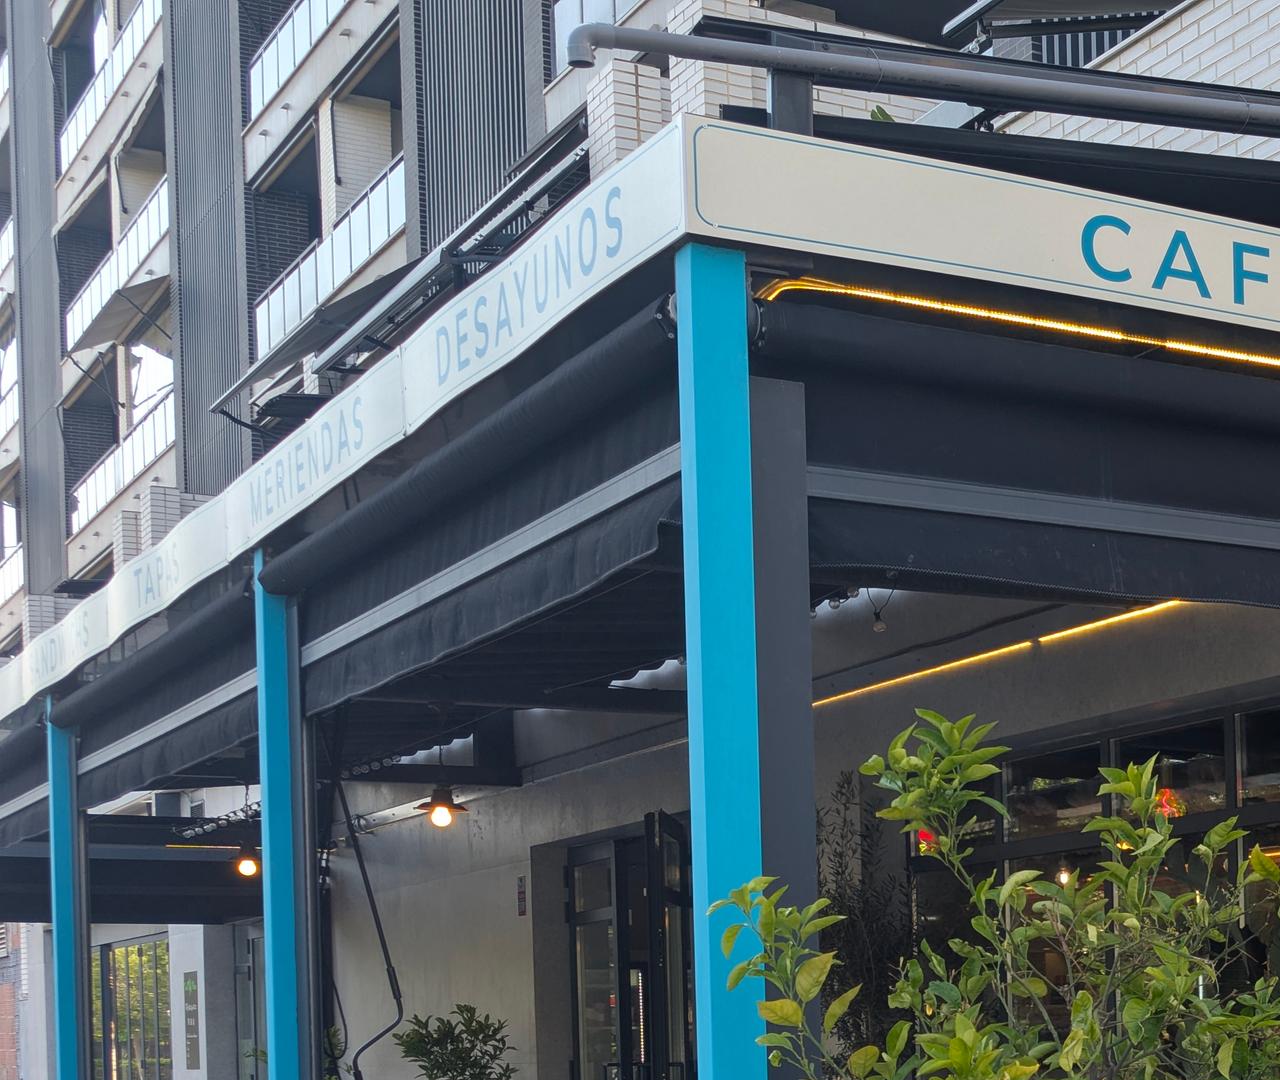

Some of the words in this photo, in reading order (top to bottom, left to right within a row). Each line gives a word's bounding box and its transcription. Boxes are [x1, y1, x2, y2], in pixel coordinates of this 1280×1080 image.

[435, 186, 623, 386] DESAYUNOS
[249, 396, 364, 527] MERIENDAS
[133, 542, 181, 609] TAPAS
